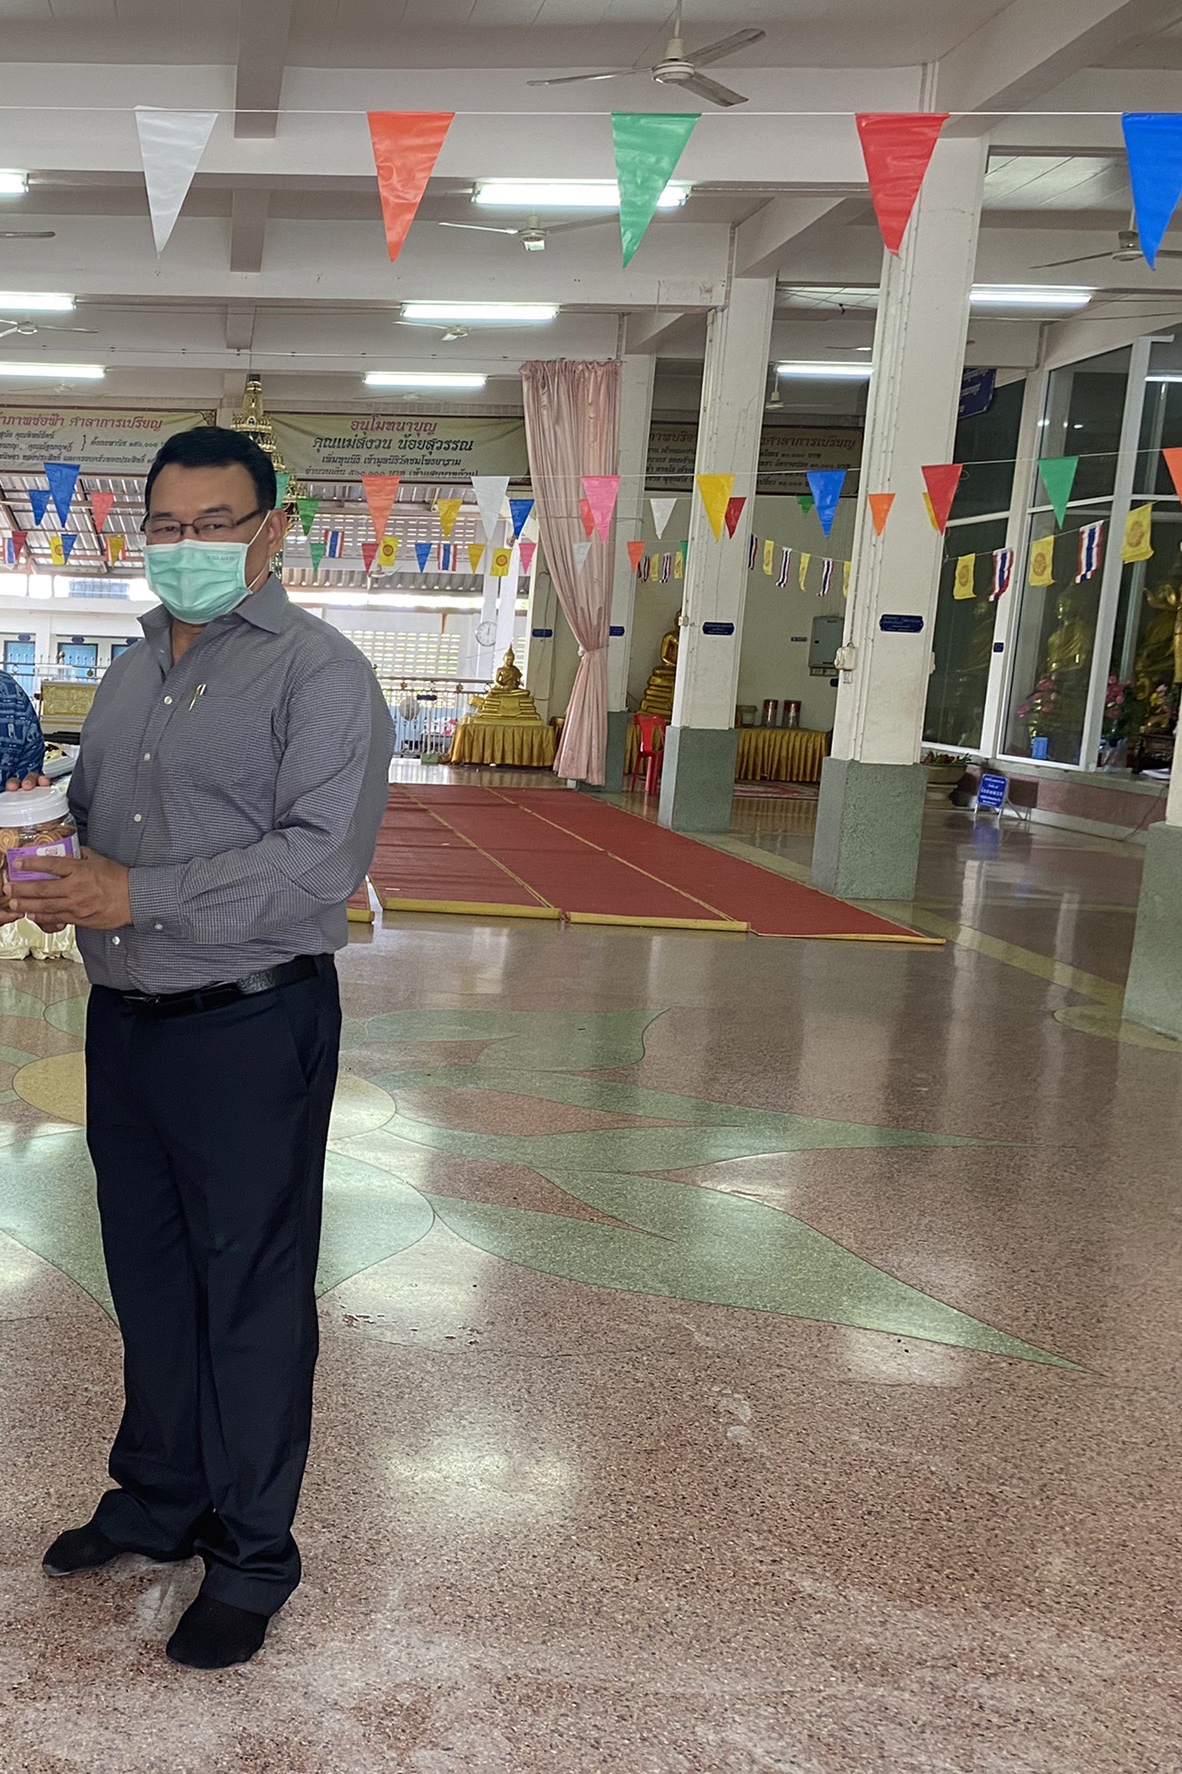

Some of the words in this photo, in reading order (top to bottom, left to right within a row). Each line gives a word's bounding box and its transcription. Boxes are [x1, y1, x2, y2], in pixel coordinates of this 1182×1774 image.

[69, 416, 163, 432] ศาลาการเปรียญ
[350, 414, 438, 437] อนุโมทนาบุญ
[312, 434, 392, 453] คุณแม่สงวน
[398, 434, 474, 457] น้อยสุวรรณ
